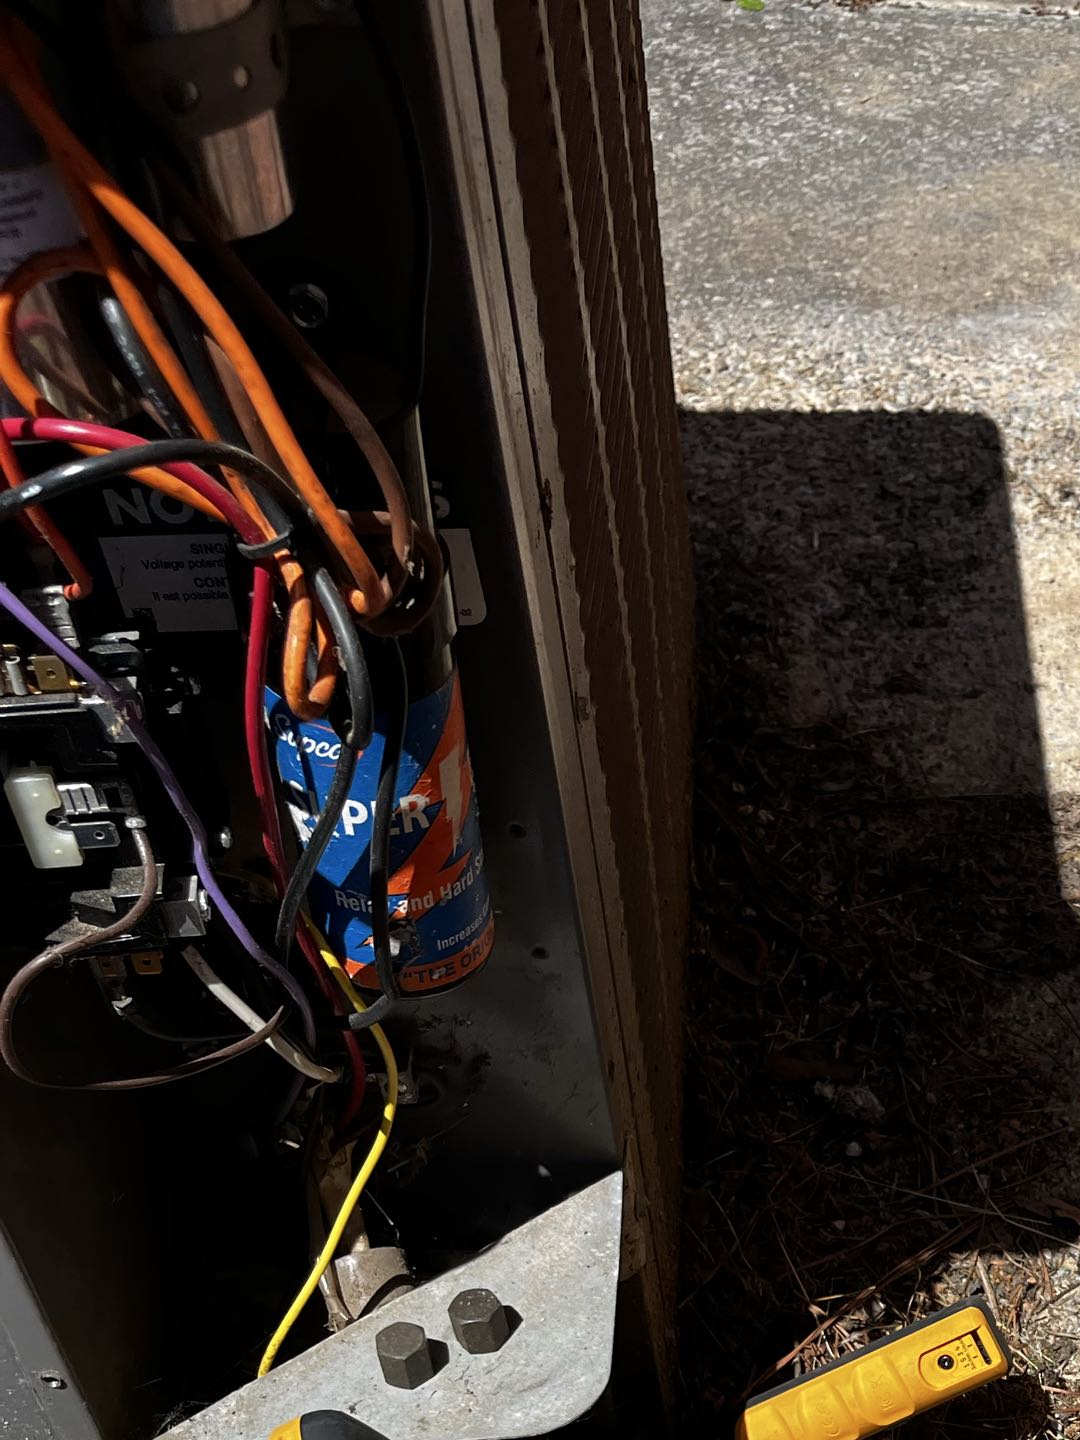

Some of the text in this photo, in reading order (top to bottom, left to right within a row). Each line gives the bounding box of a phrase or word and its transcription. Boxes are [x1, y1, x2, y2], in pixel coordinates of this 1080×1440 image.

[141, 558, 226, 571] Voltage potent
[396, 890, 434, 914] and
[439, 866, 474, 902] Hard
[437, 915, 484, 951] Increases
